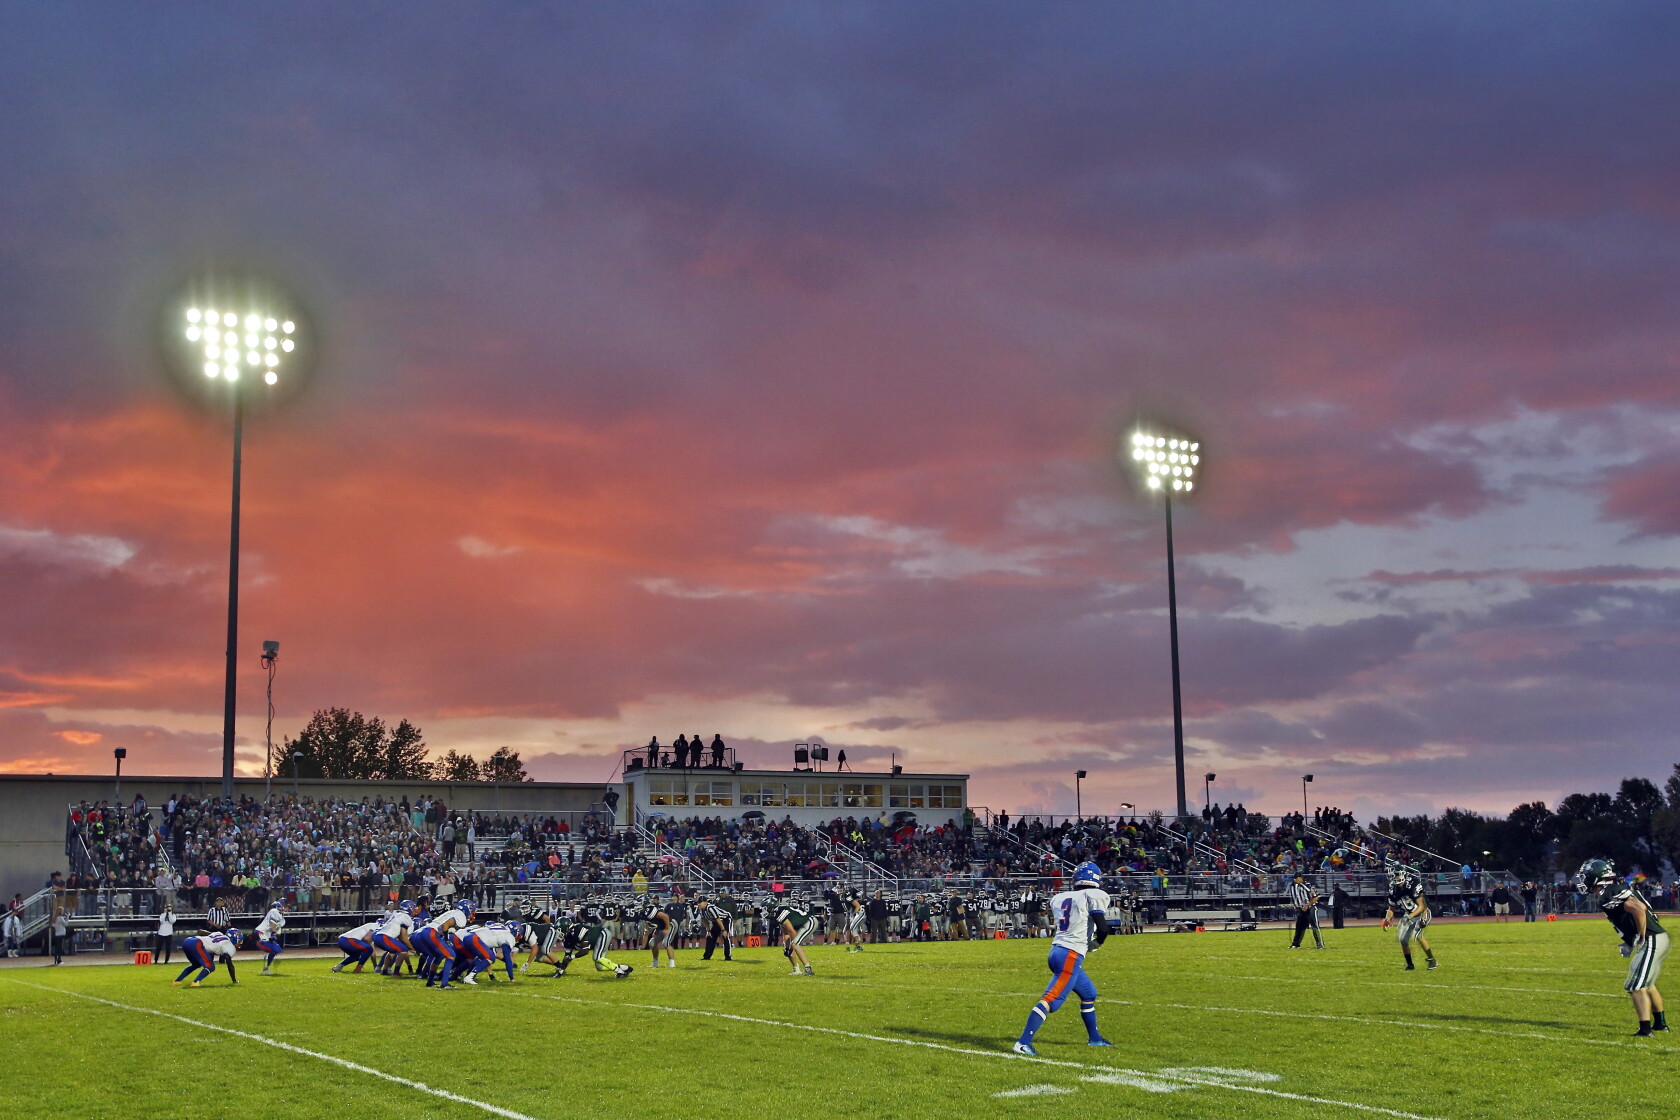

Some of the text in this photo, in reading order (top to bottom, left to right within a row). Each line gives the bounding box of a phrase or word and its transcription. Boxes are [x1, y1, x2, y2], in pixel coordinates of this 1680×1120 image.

[968, 903, 977, 912] 54
[1010, 901, 1020, 910] 39
[605, 907, 615, 917] 13
[625, 908, 636, 918] 35
[1059, 898, 1073, 932] 3
[750, 938, 760, 947] 30
[137, 953, 149, 965] 10
